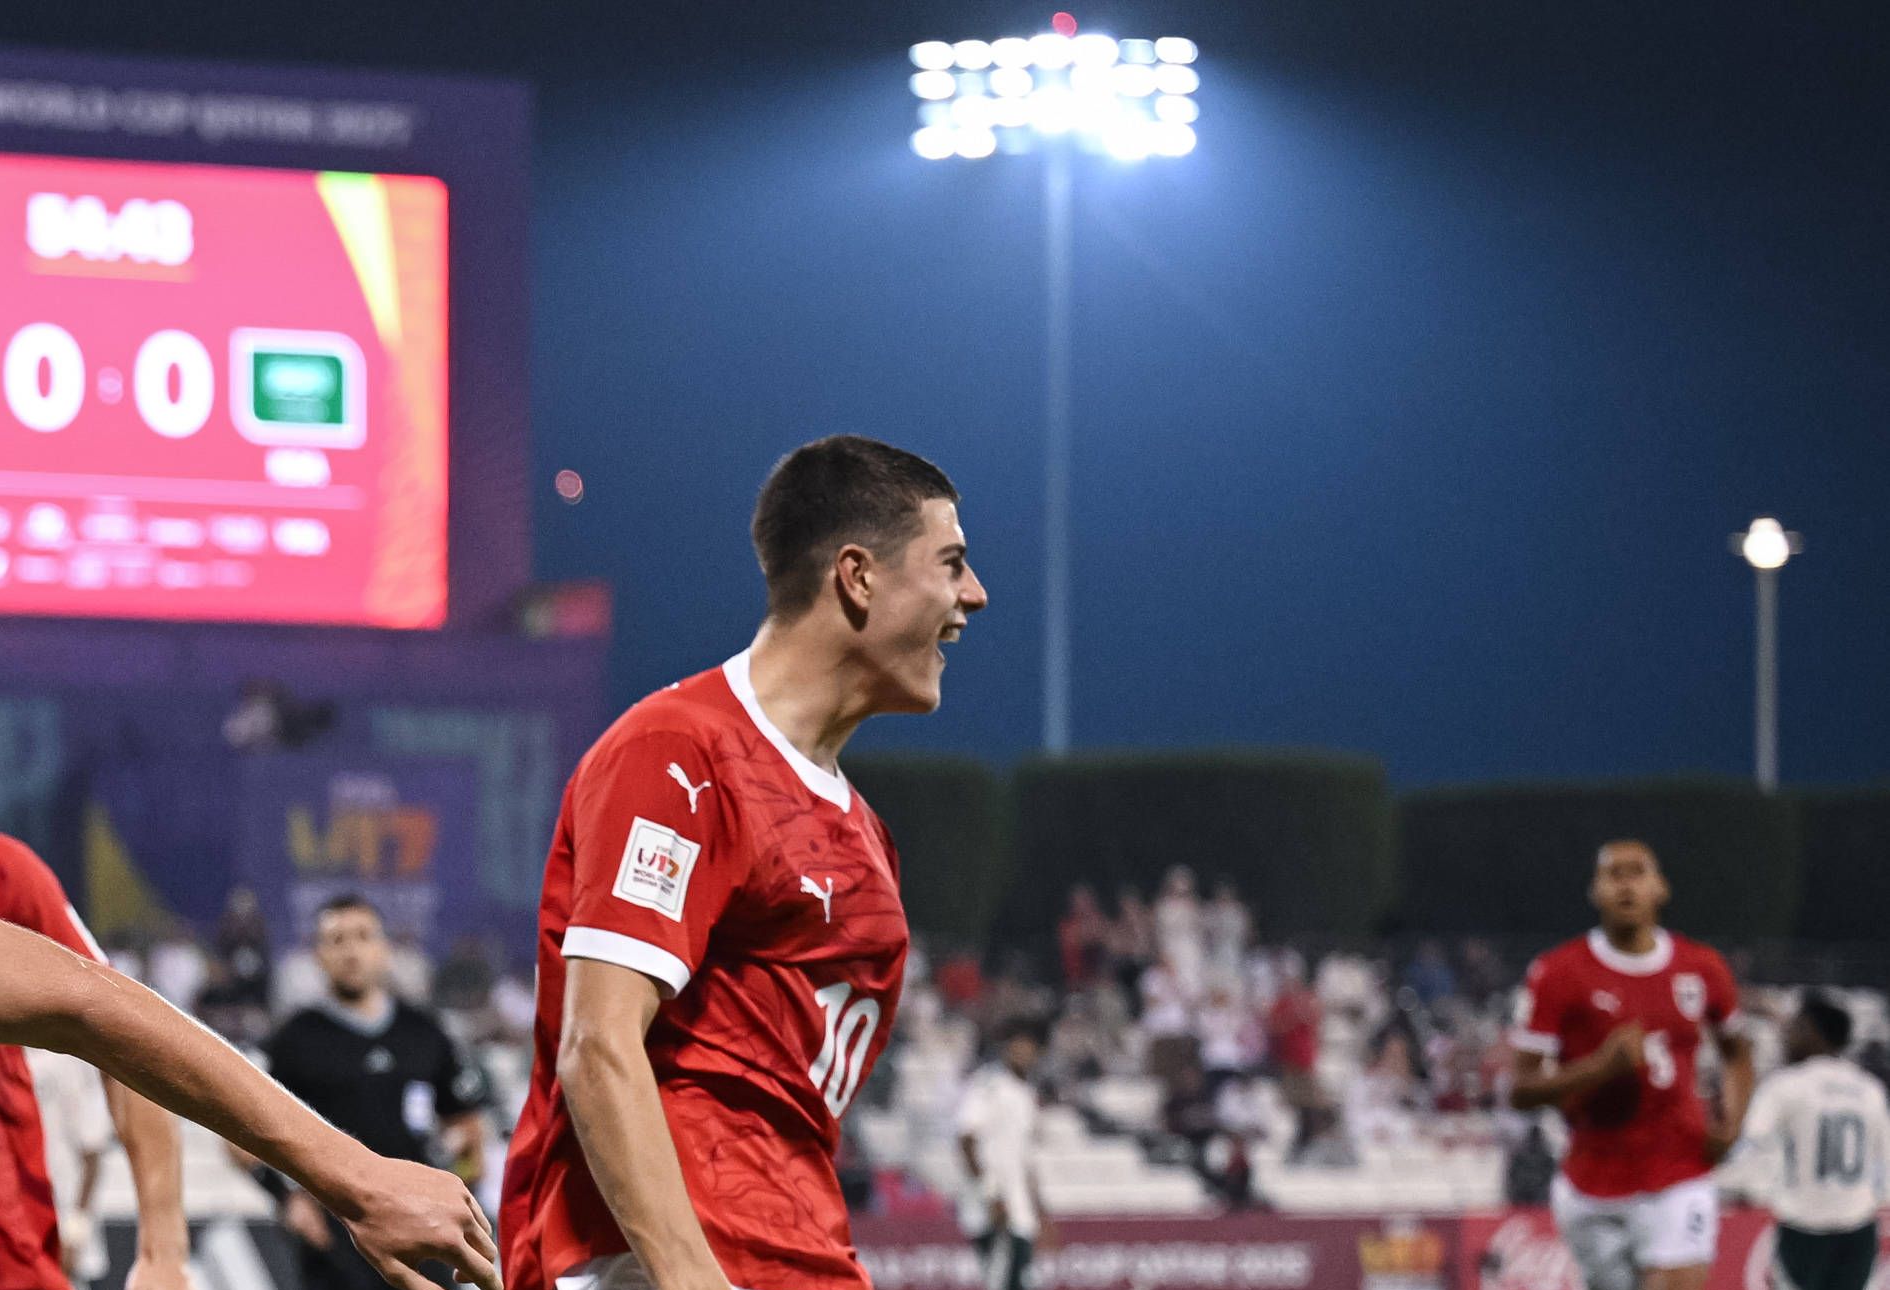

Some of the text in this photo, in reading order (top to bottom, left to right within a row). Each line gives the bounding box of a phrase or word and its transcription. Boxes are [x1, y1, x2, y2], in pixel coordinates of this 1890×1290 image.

[4, 322, 214, 438] 0 0
[809, 981, 880, 1119] 10
